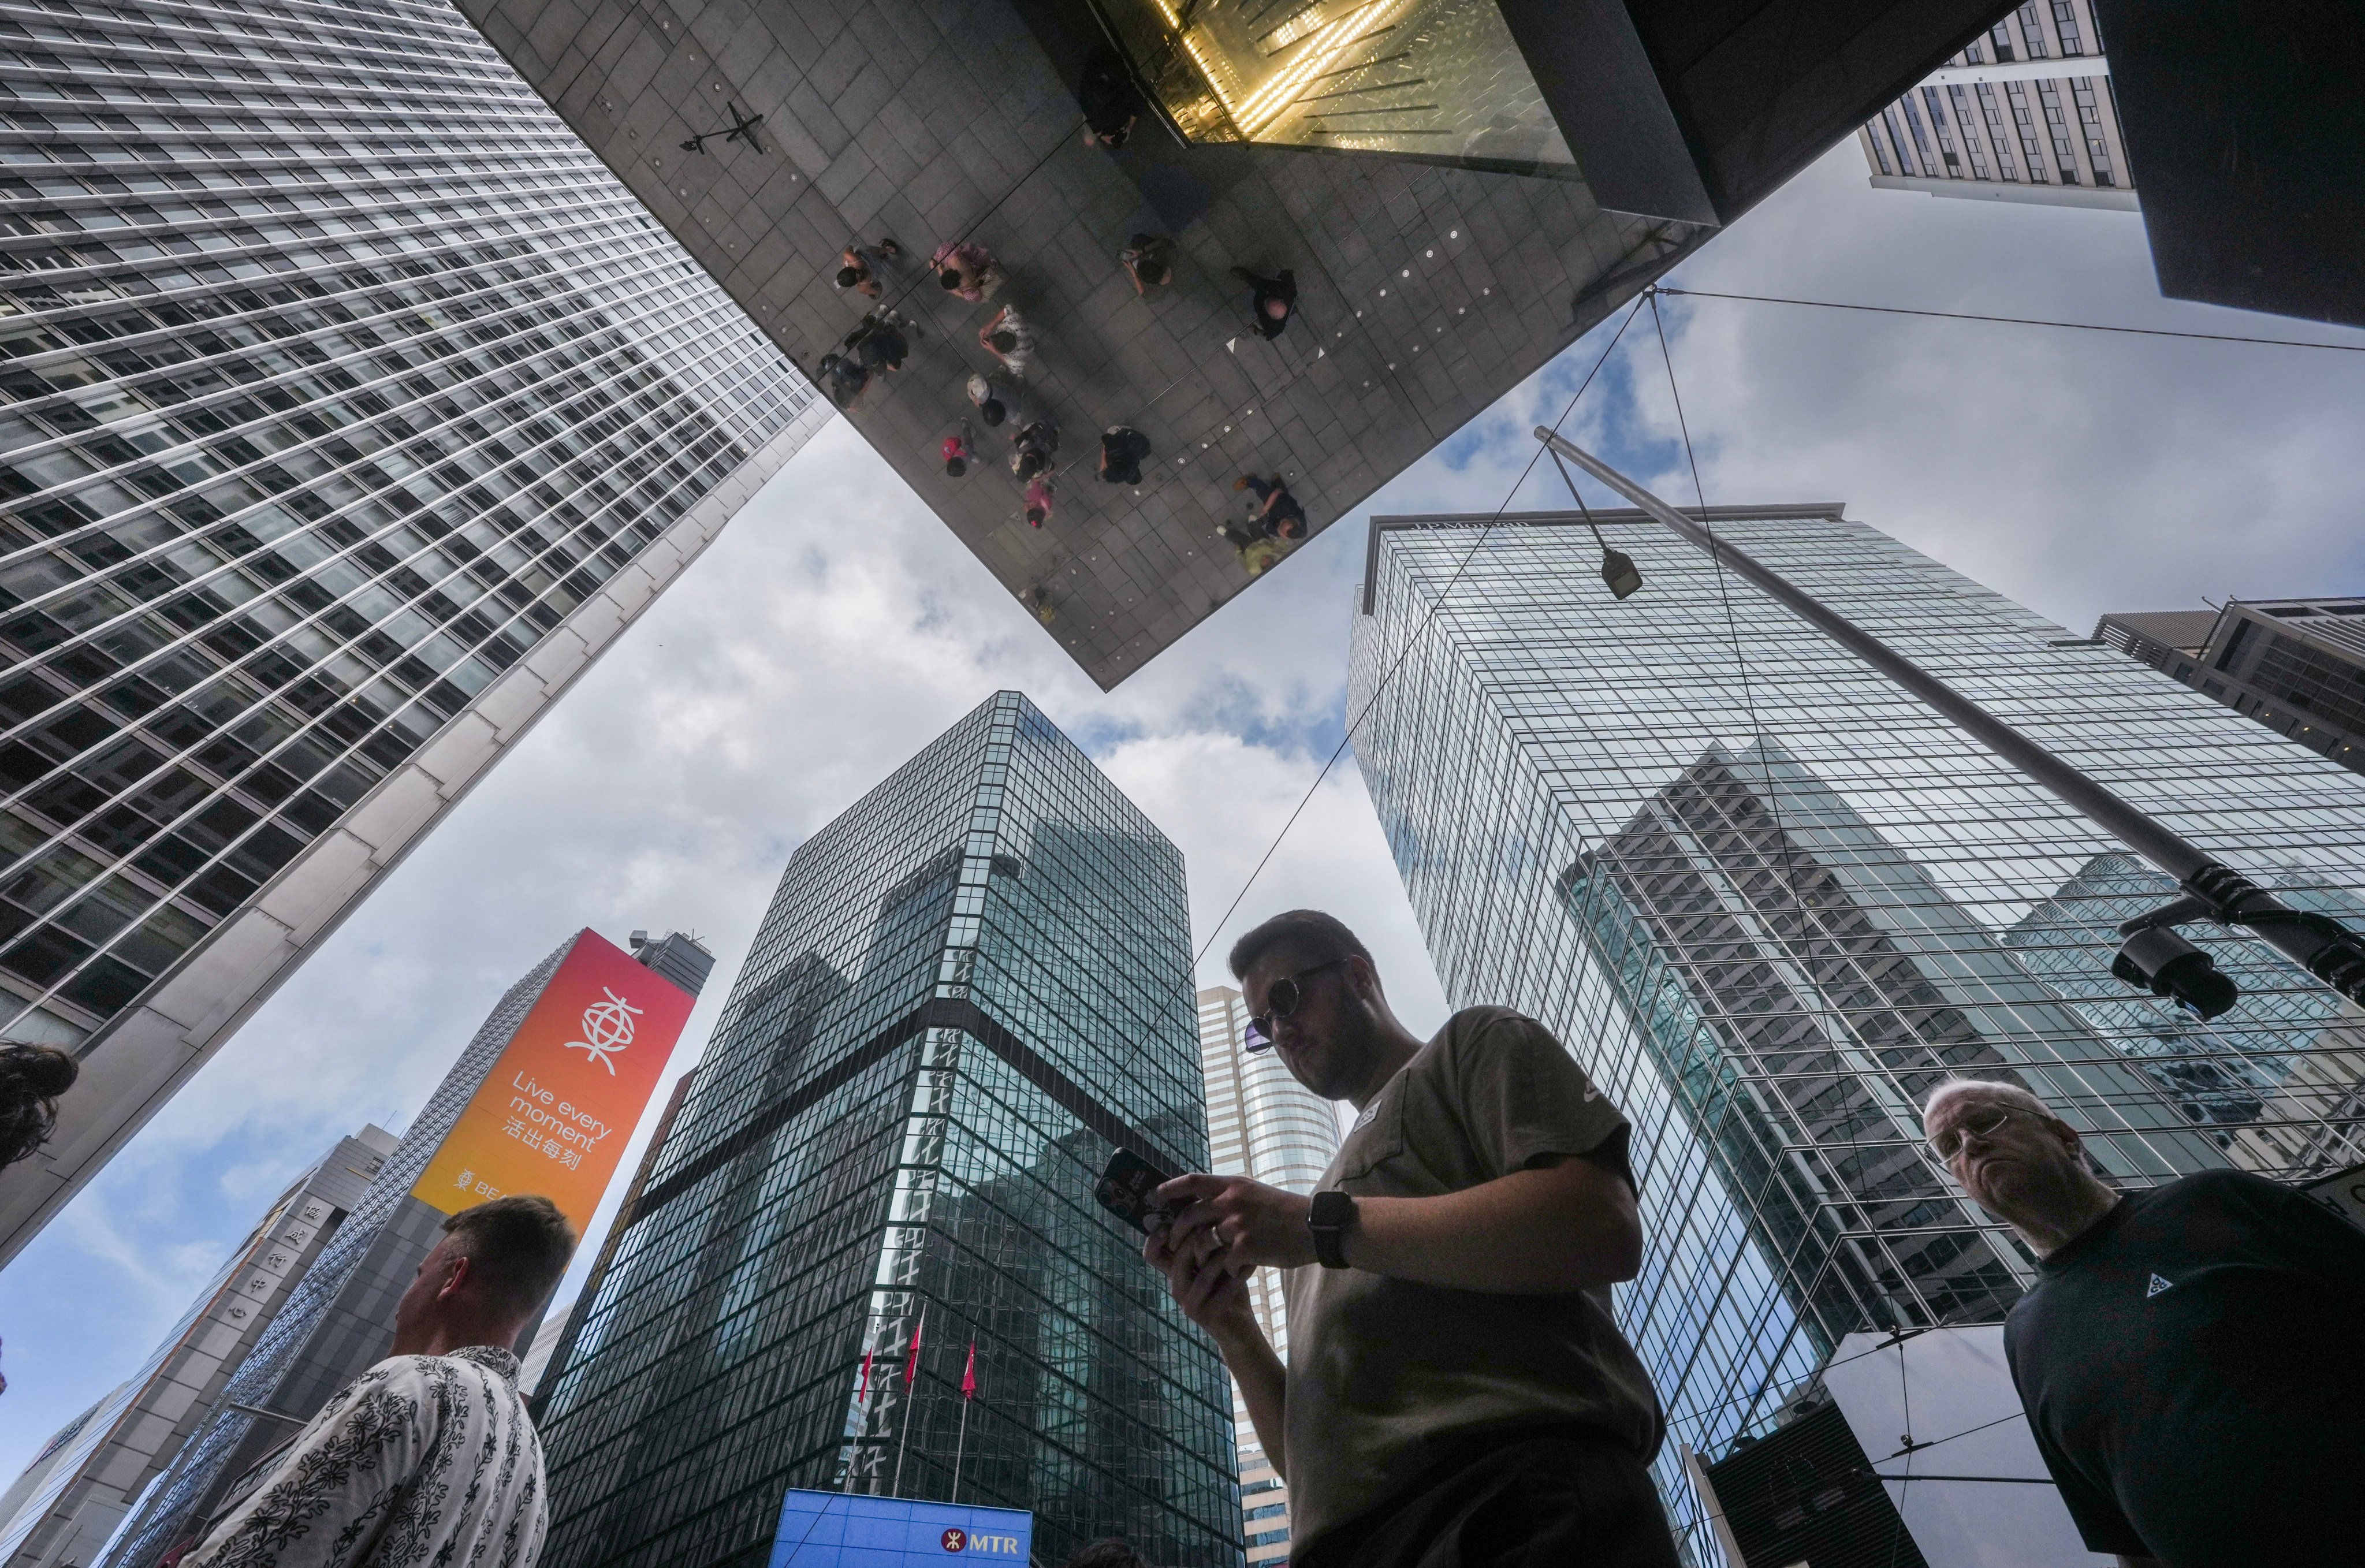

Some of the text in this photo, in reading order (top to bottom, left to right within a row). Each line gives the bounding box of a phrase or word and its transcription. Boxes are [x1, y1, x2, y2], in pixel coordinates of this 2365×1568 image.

[509, 1096, 596, 1153] moment
[512, 1071, 612, 1140] Live every
[502, 1115, 582, 1171] 活出每刻
[229, 1202, 322, 1318] 協成行中心
[970, 1534, 1017, 1554] MTR
